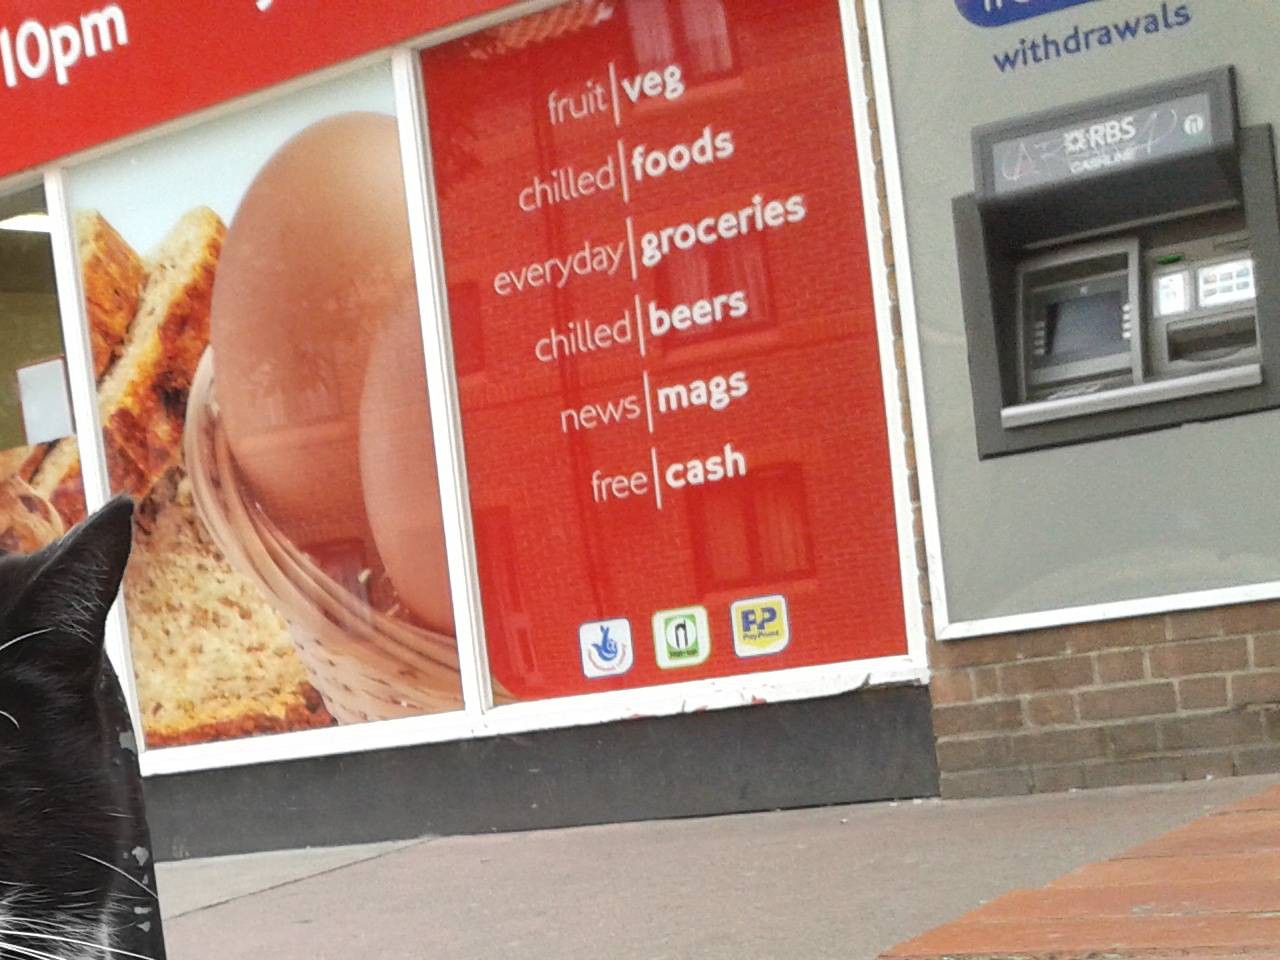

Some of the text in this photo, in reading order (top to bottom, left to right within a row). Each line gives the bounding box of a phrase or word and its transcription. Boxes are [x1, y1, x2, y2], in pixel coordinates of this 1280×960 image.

[993, 3, 1191, 73] withdrawals
[547, 63, 686, 125] fruit veg
[1088, 116, 1137, 149] RBS
[518, 126, 736, 213] chilled foods
[493, 192, 808, 296] everyday groceries
[534, 290, 750, 363] chilled beers
[560, 370, 750, 433] news mags
[591, 442, 748, 502] free cash
